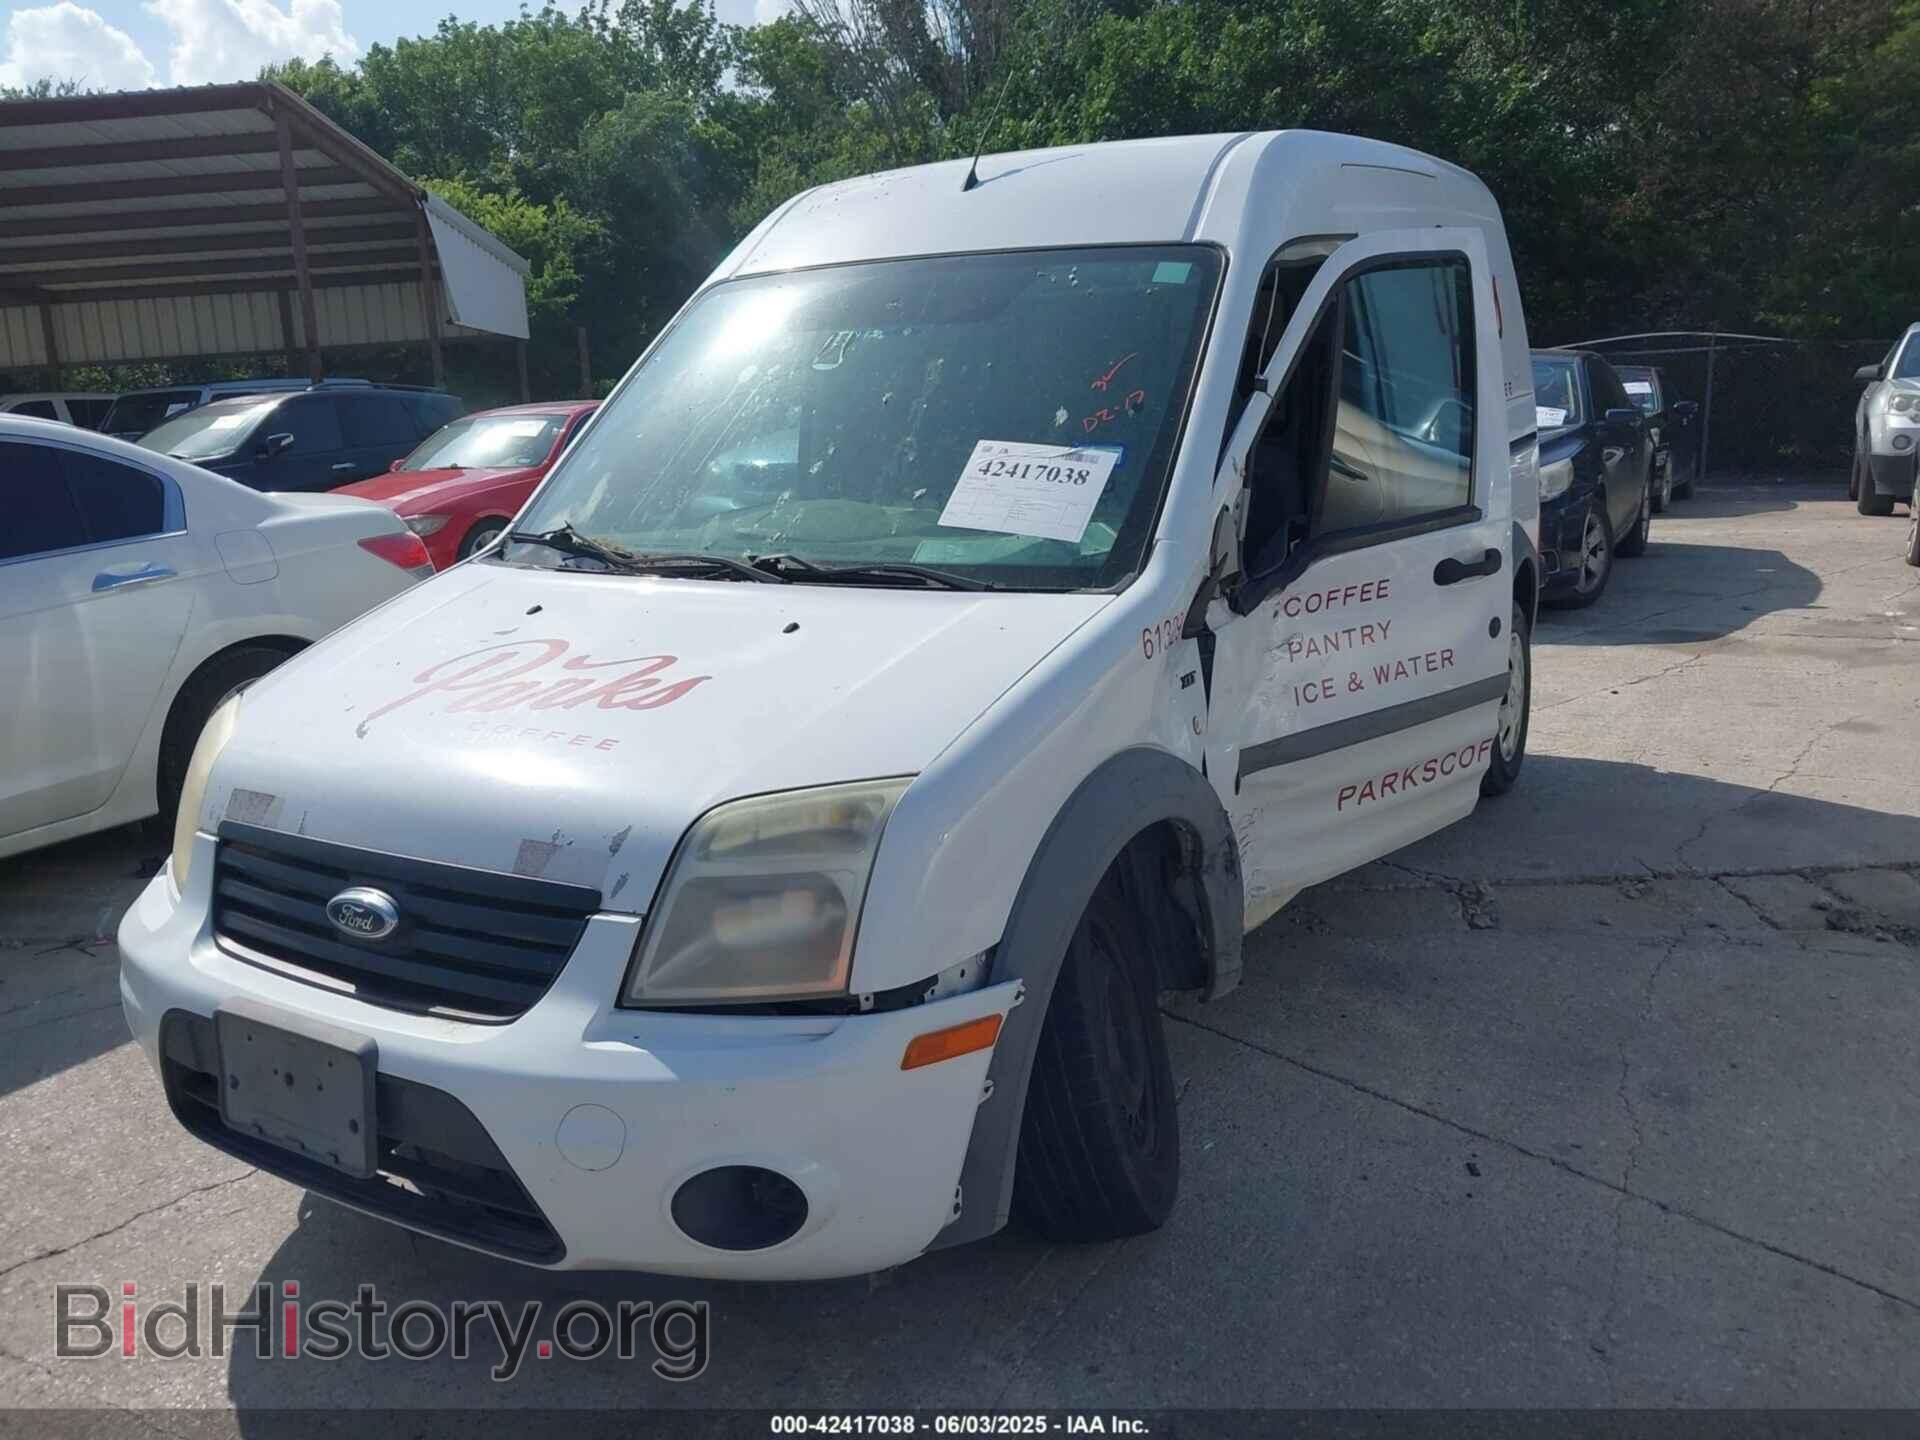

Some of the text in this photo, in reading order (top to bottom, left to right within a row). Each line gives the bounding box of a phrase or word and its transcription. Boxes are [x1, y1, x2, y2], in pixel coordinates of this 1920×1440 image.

[977, 459, 1091, 486] 42417038
[1283, 579, 1391, 618] COFFEE
[1287, 619, 1392, 663] PANTRY
[357, 638, 712, 738] Parks
[1293, 648, 1455, 707] ICE & WATER
[339, 903, 374, 931] Ford
